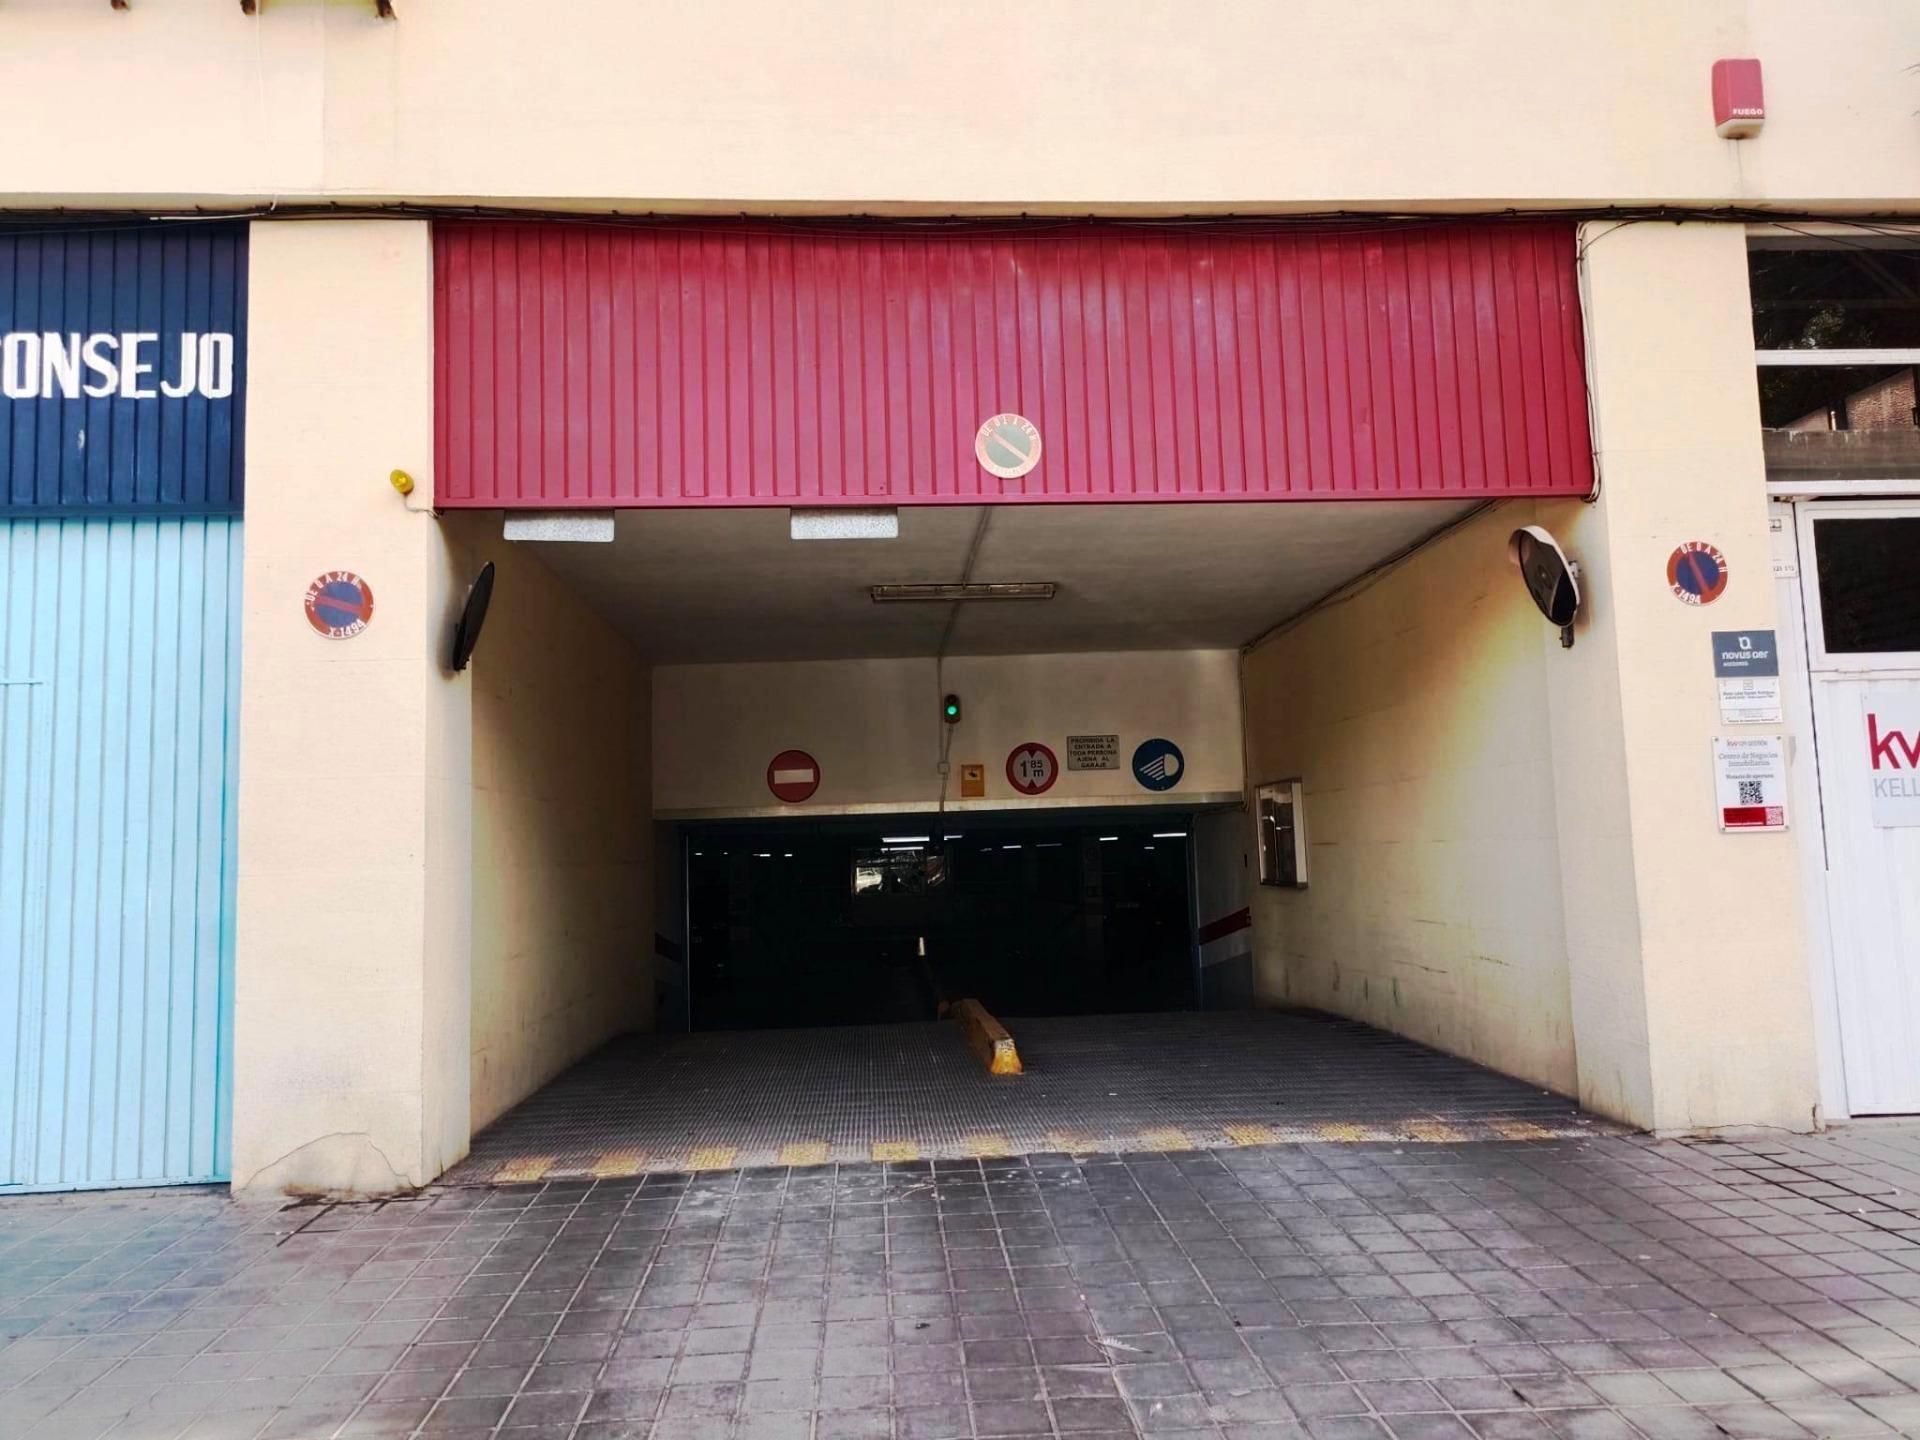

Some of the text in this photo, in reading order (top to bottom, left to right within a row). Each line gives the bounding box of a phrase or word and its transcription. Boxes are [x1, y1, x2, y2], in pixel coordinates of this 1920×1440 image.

[1732, 108, 1763, 116] FUEGO
[0, 332, 234, 399] ONSEJO
[1680, 542, 1695, 555] DE
[1704, 543, 1712, 555] A
[1712, 551, 1727, 565] 24
[305, 588, 319, 602] DE
[325, 573, 334, 585] A
[336, 571, 349, 583] 24
[1721, 651, 1751, 660] novus
[1033, 769, 1044, 777] m
